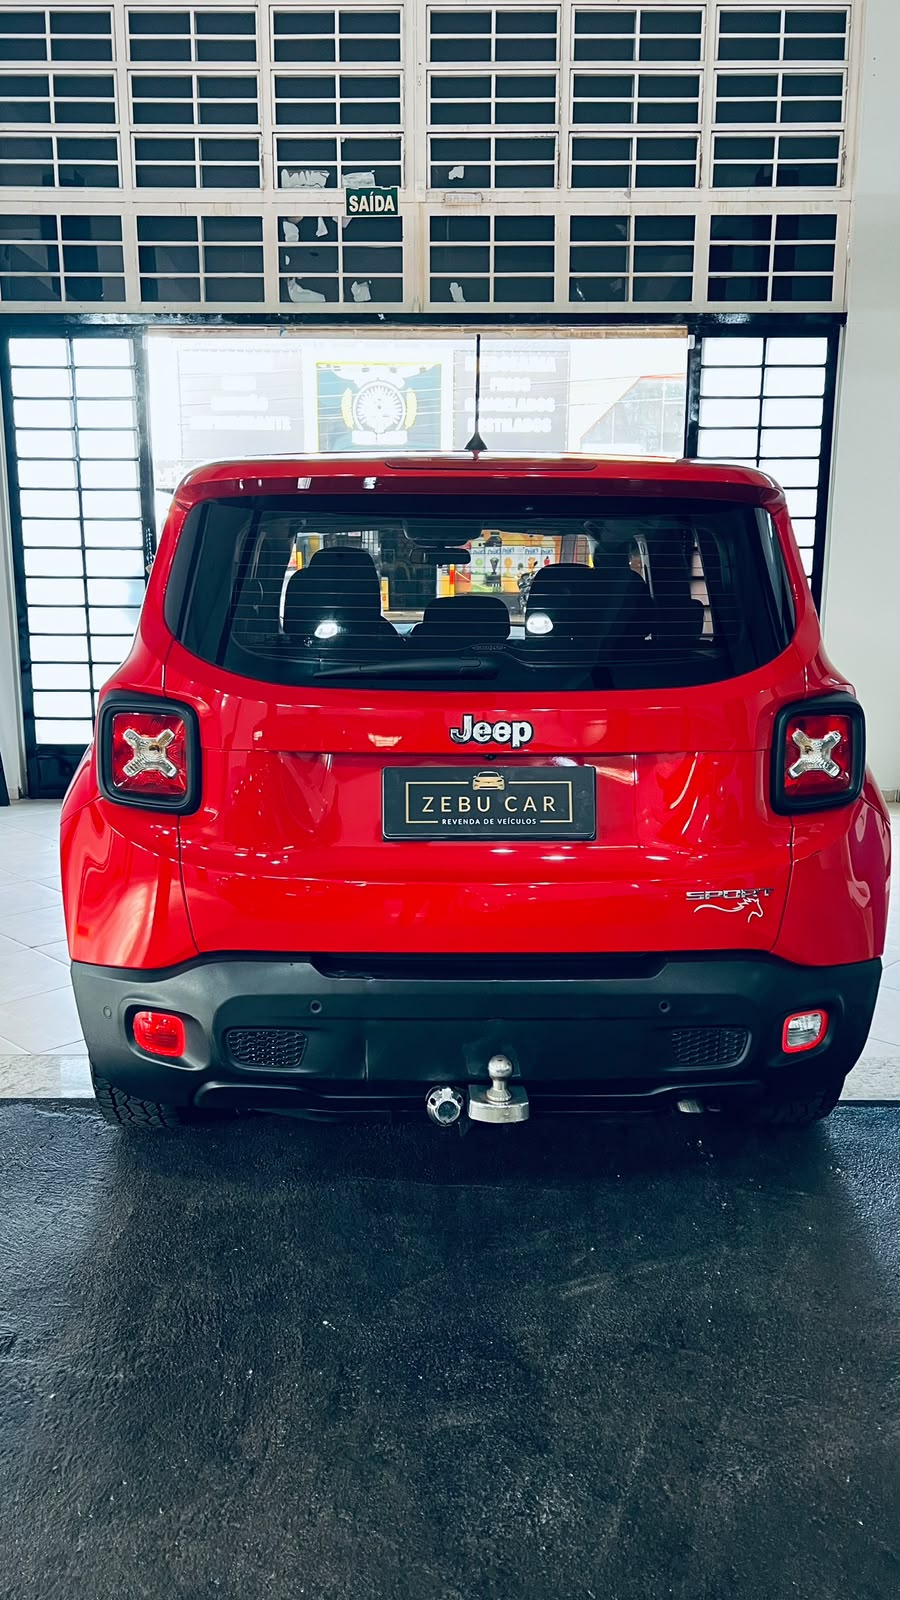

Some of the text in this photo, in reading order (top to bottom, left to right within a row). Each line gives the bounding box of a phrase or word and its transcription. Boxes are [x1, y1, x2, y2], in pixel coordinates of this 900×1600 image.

[349, 191, 395, 212] SAÍDA
[450, 714, 532, 748] Jeep
[422, 796, 556, 813] ZEBU CAR
[497, 816, 537, 825] VEÍCULOS
[686, 888, 774, 900] SPORT
